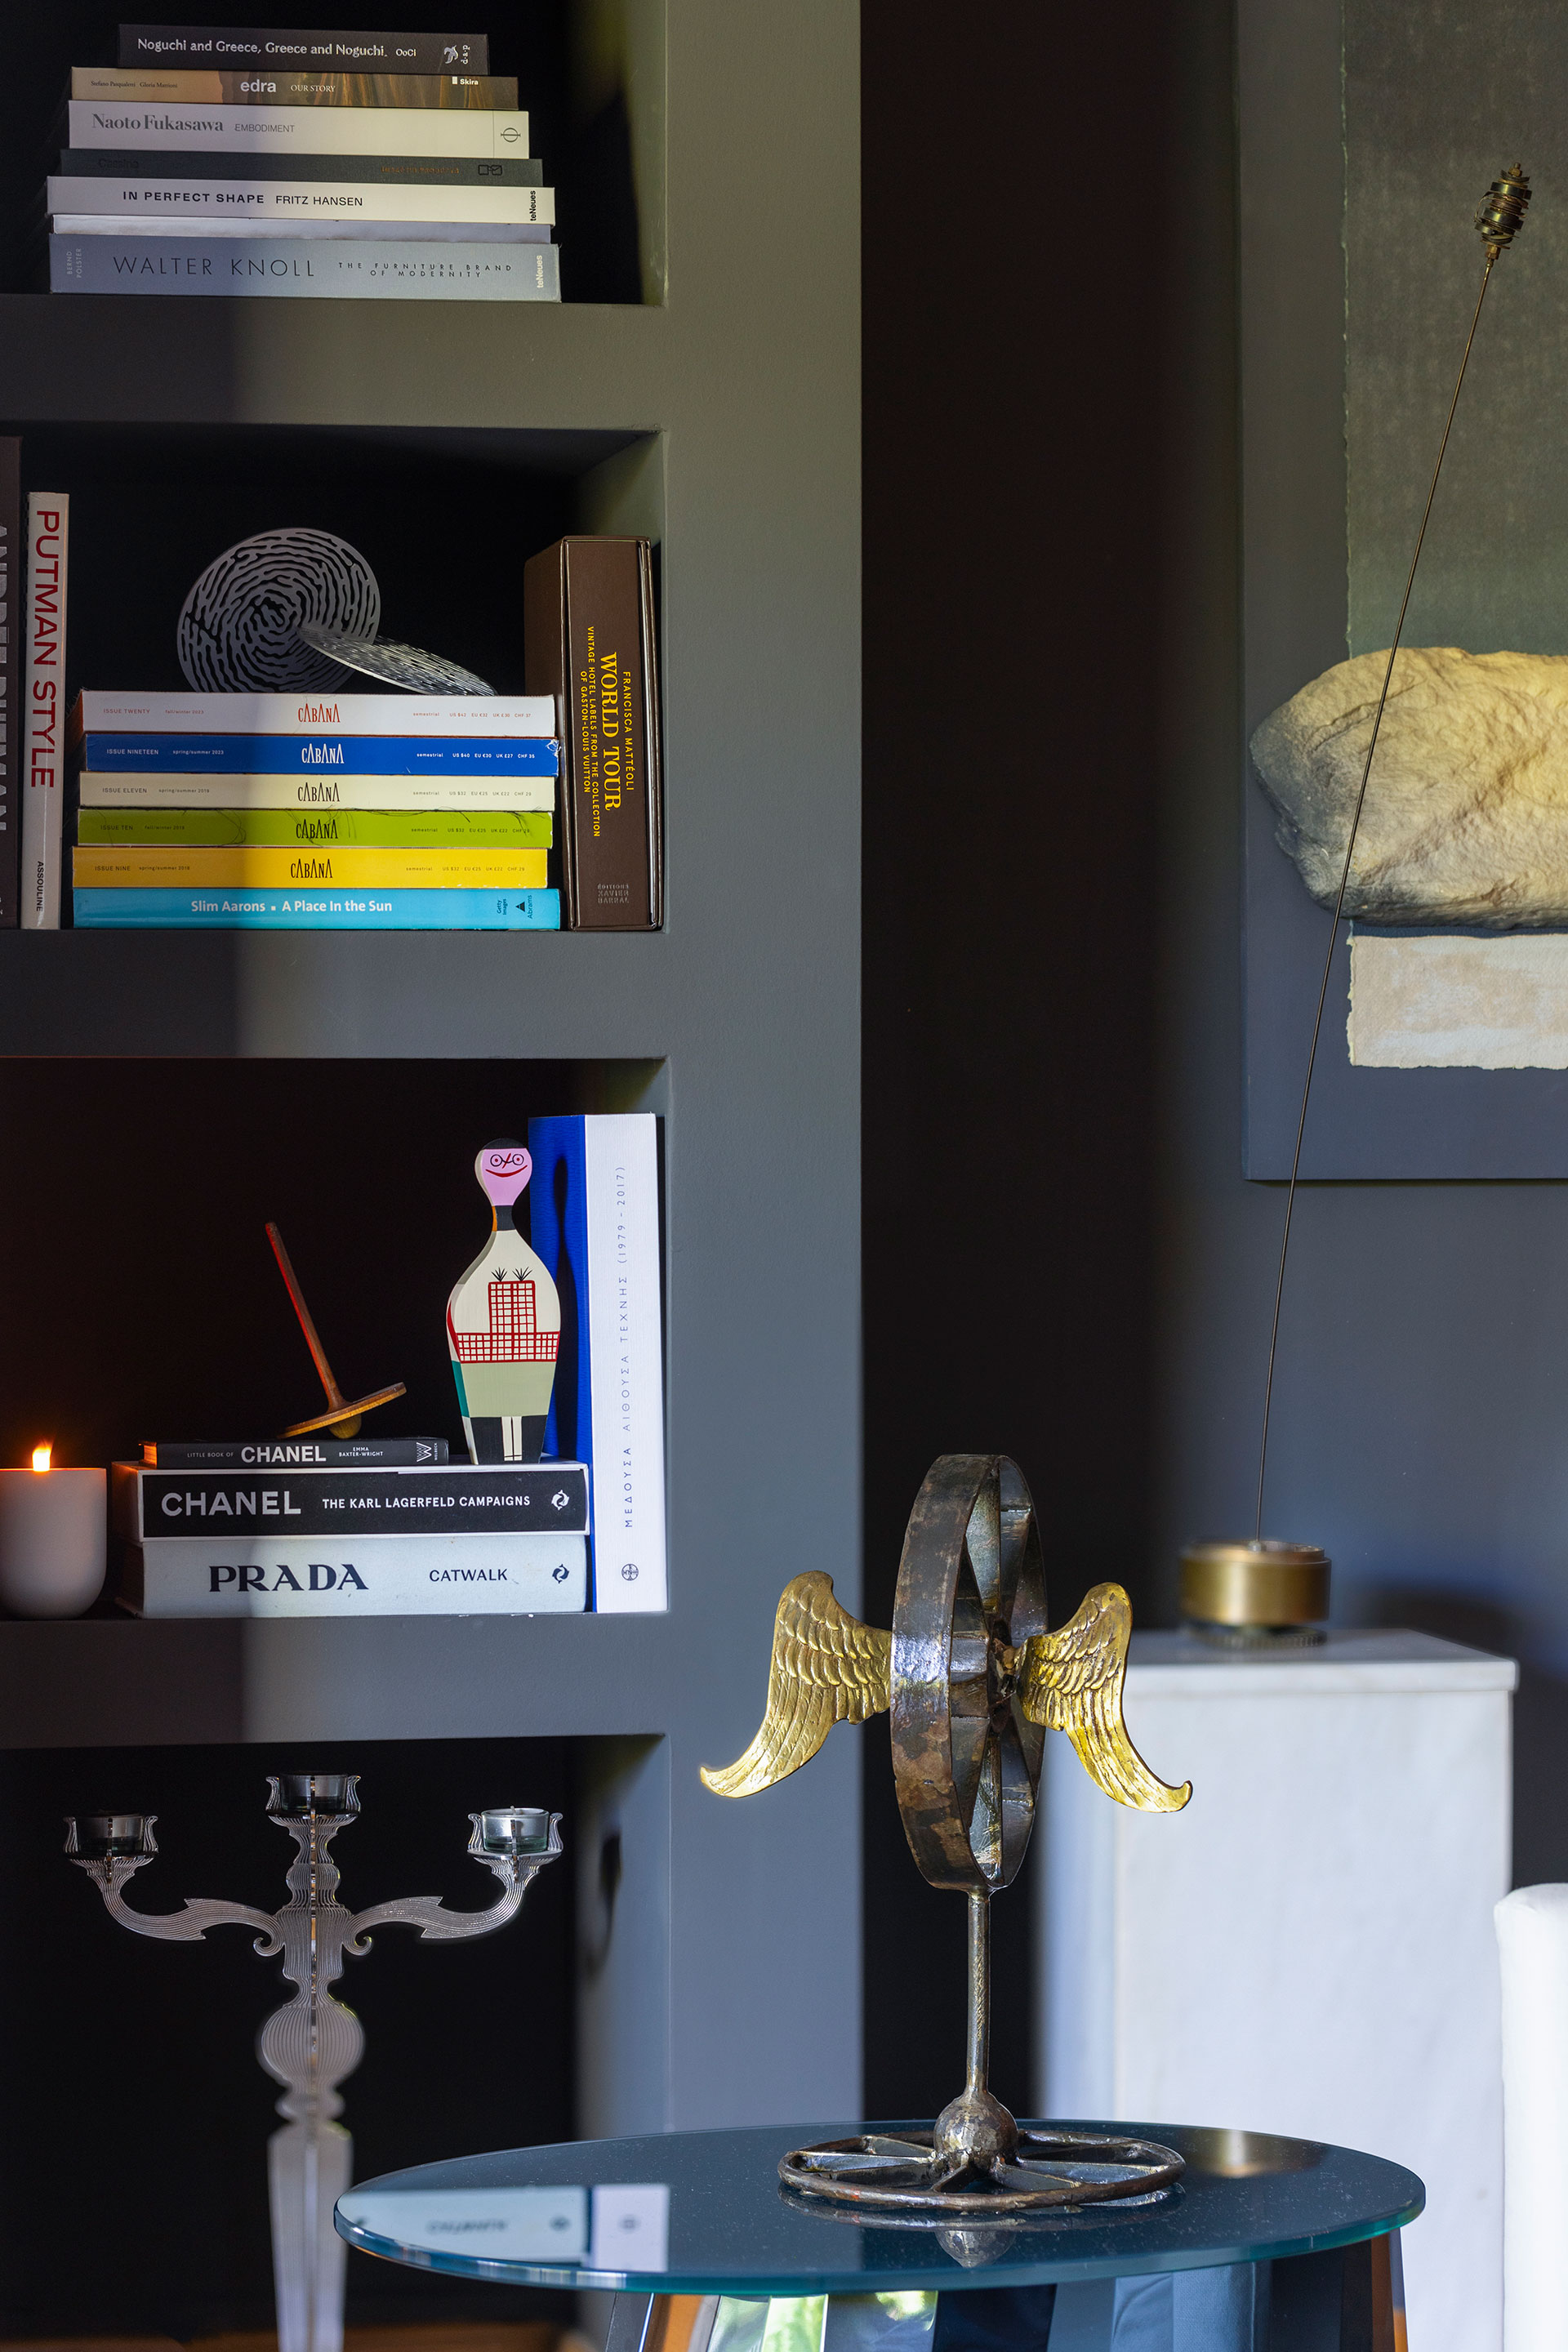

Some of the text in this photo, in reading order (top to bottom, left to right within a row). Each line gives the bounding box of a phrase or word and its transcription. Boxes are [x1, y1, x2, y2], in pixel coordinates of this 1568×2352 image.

[138, 38, 186, 51] Noguchi
[190, 40, 212, 51] and
[216, 41, 261, 53] Greece,
[265, 42, 307, 54] Greece
[310, 44, 332, 55] and
[240, 79, 336, 93] edra OUR STORY
[92, 113, 224, 131] Naoto Fukasawa
[234, 123, 295, 133] EMBODIMENT
[123, 191, 265, 204] IN PERFECT SHAPE
[276, 195, 363, 207] FRITZ HANSEN
[114, 256, 314, 277] WALTER KNOLL
[31, 510, 60, 788] PUTMAN STYLE
[587, 626, 595, 663] VINTAGE
[588, 666, 596, 695] HOTEL
[297, 703, 341, 723] CABANA
[580, 670, 590, 793] OF GASTON-LOUIS VUITTON
[600, 652, 621, 811] WORLD TOUR
[623, 671, 635, 791] FRANCISCA MATTÉOLI
[301, 743, 345, 764] CABANA
[297, 782, 341, 802] CABANA
[592, 781, 600, 837] COLLECTION
[296, 819, 338, 839] CABANA
[291, 858, 333, 879] CABANA
[36, 861, 45, 912] ASSOULINE
[191, 900, 265, 912] Slim Aarons
[282, 900, 392, 912] A Place In the Sun
[615, 1167, 626, 1205] 2017)
[617, 1225, 627, 1263] (1979
[618, 1276, 629, 1343] ΤΕΧΝΗΣ
[621, 1355, 630, 1432] ΑΙΘΟΥΣΑ
[241, 1446, 327, 1463] CHANEL
[623, 1448, 633, 1527] ΜΕΔΟΥΣΑ
[161, 1490, 531, 1517] CHANEL THE KARL LAGERFELD CAMPAIGNS
[209, 1563, 508, 1592] PRADA CATWALK
